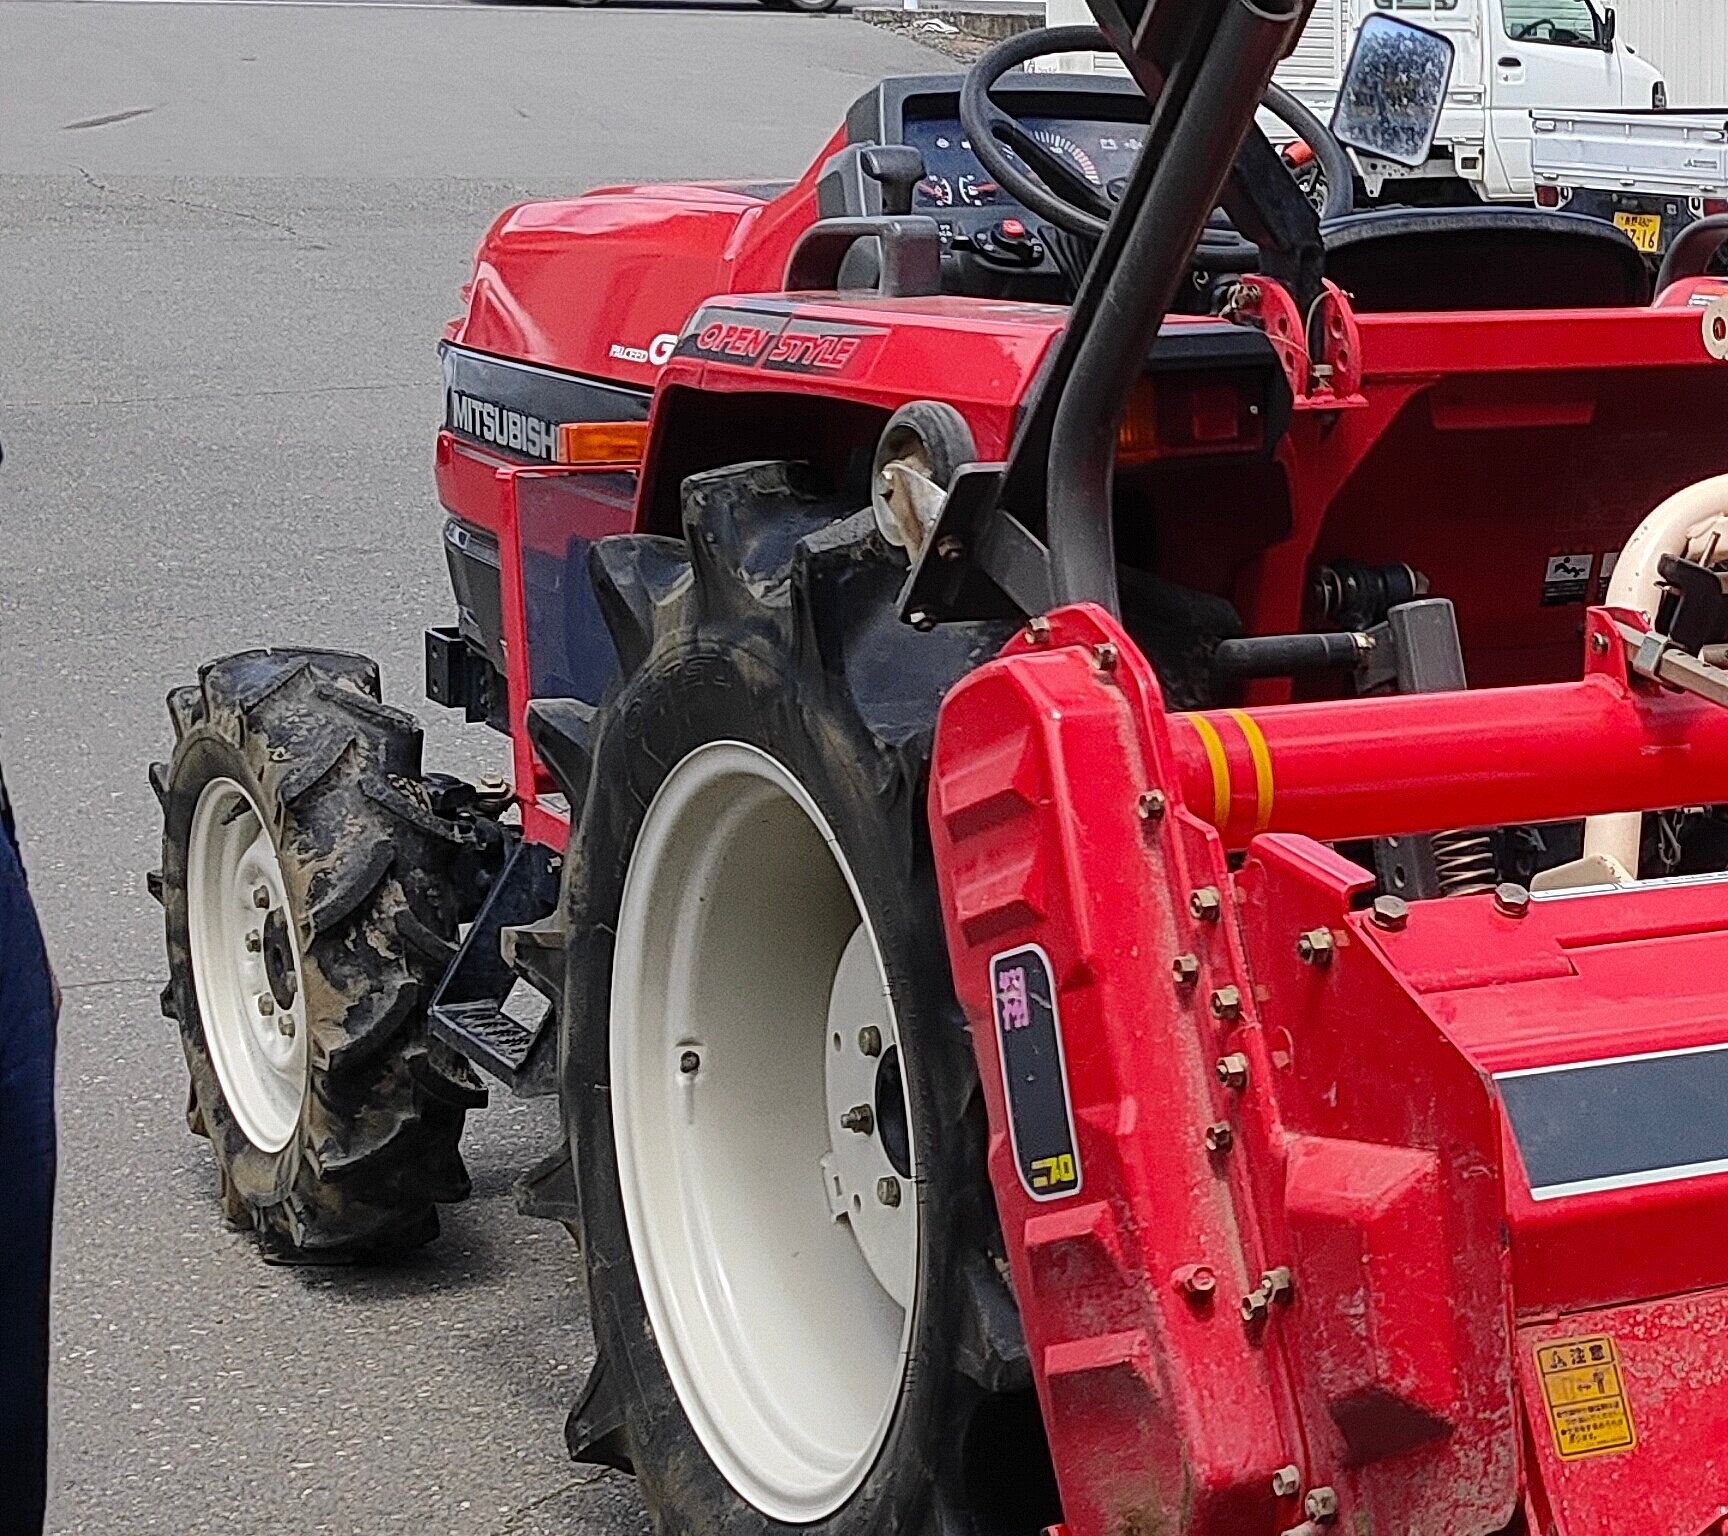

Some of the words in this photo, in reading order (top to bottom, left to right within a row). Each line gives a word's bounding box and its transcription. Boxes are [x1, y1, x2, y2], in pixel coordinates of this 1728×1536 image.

[697, 322, 770, 357] OPEN
[768, 333, 861, 369] STYLE
[453, 391, 559, 462] MITSUBISH
